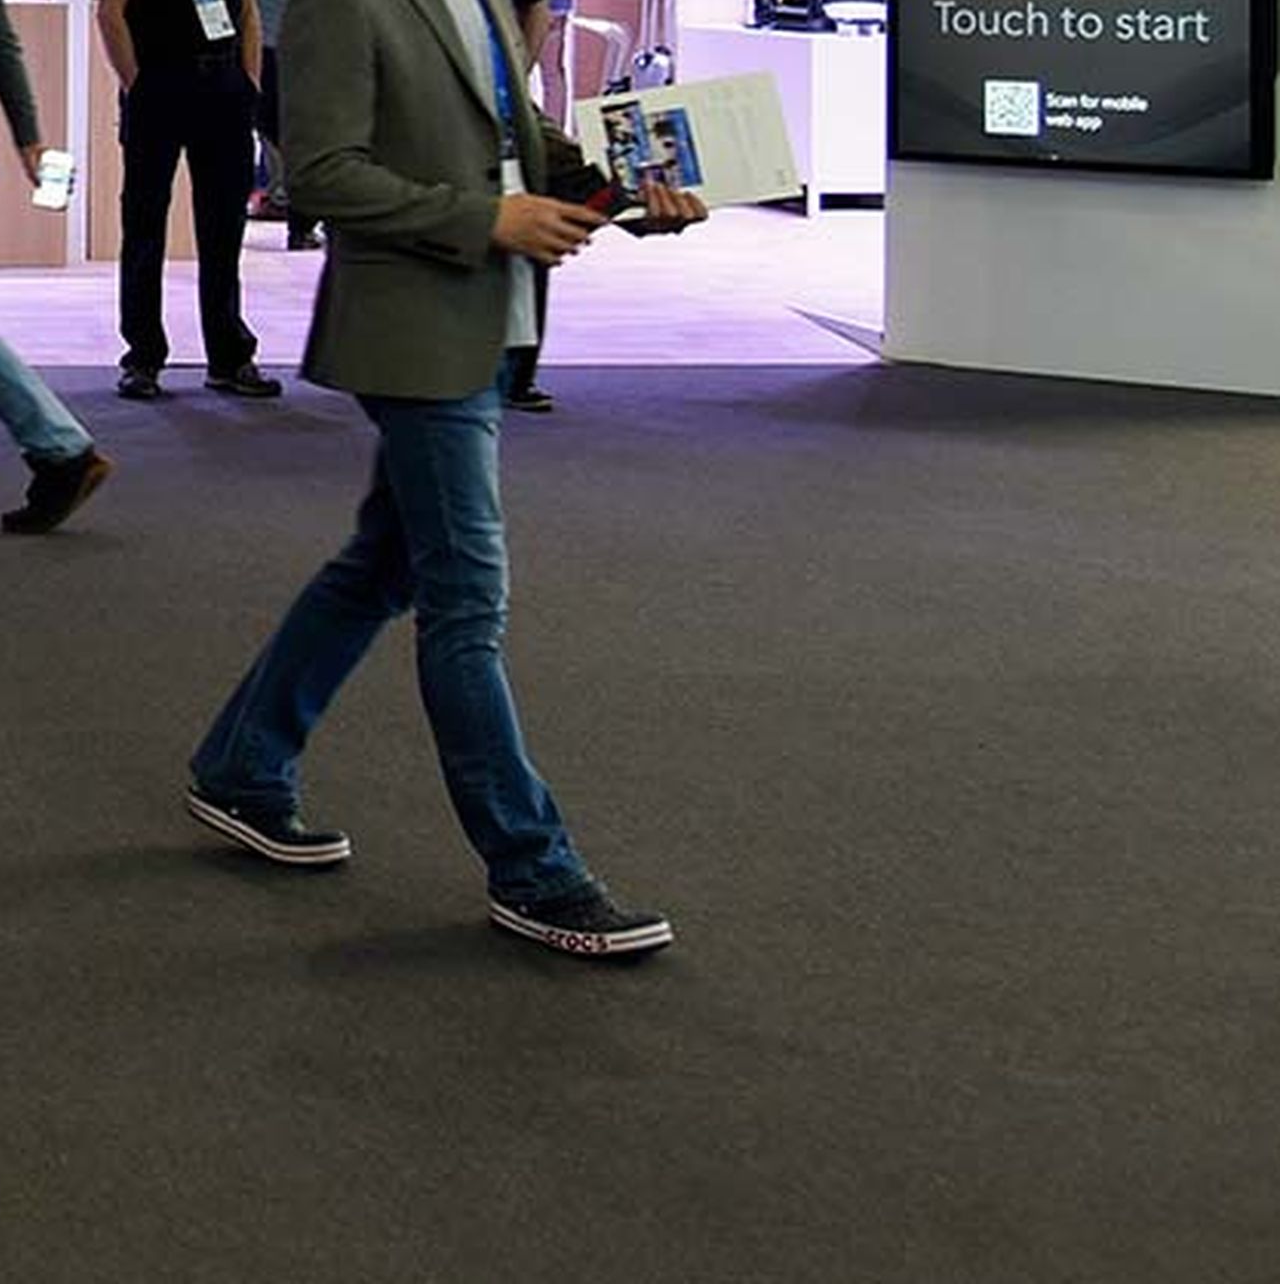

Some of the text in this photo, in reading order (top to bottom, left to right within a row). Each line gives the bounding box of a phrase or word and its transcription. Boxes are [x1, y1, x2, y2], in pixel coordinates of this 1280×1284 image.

[933, 0, 1210, 43] Touch to start
[1045, 93, 1148, 112] Scan for mobile
[1045, 115, 1102, 131] web app
